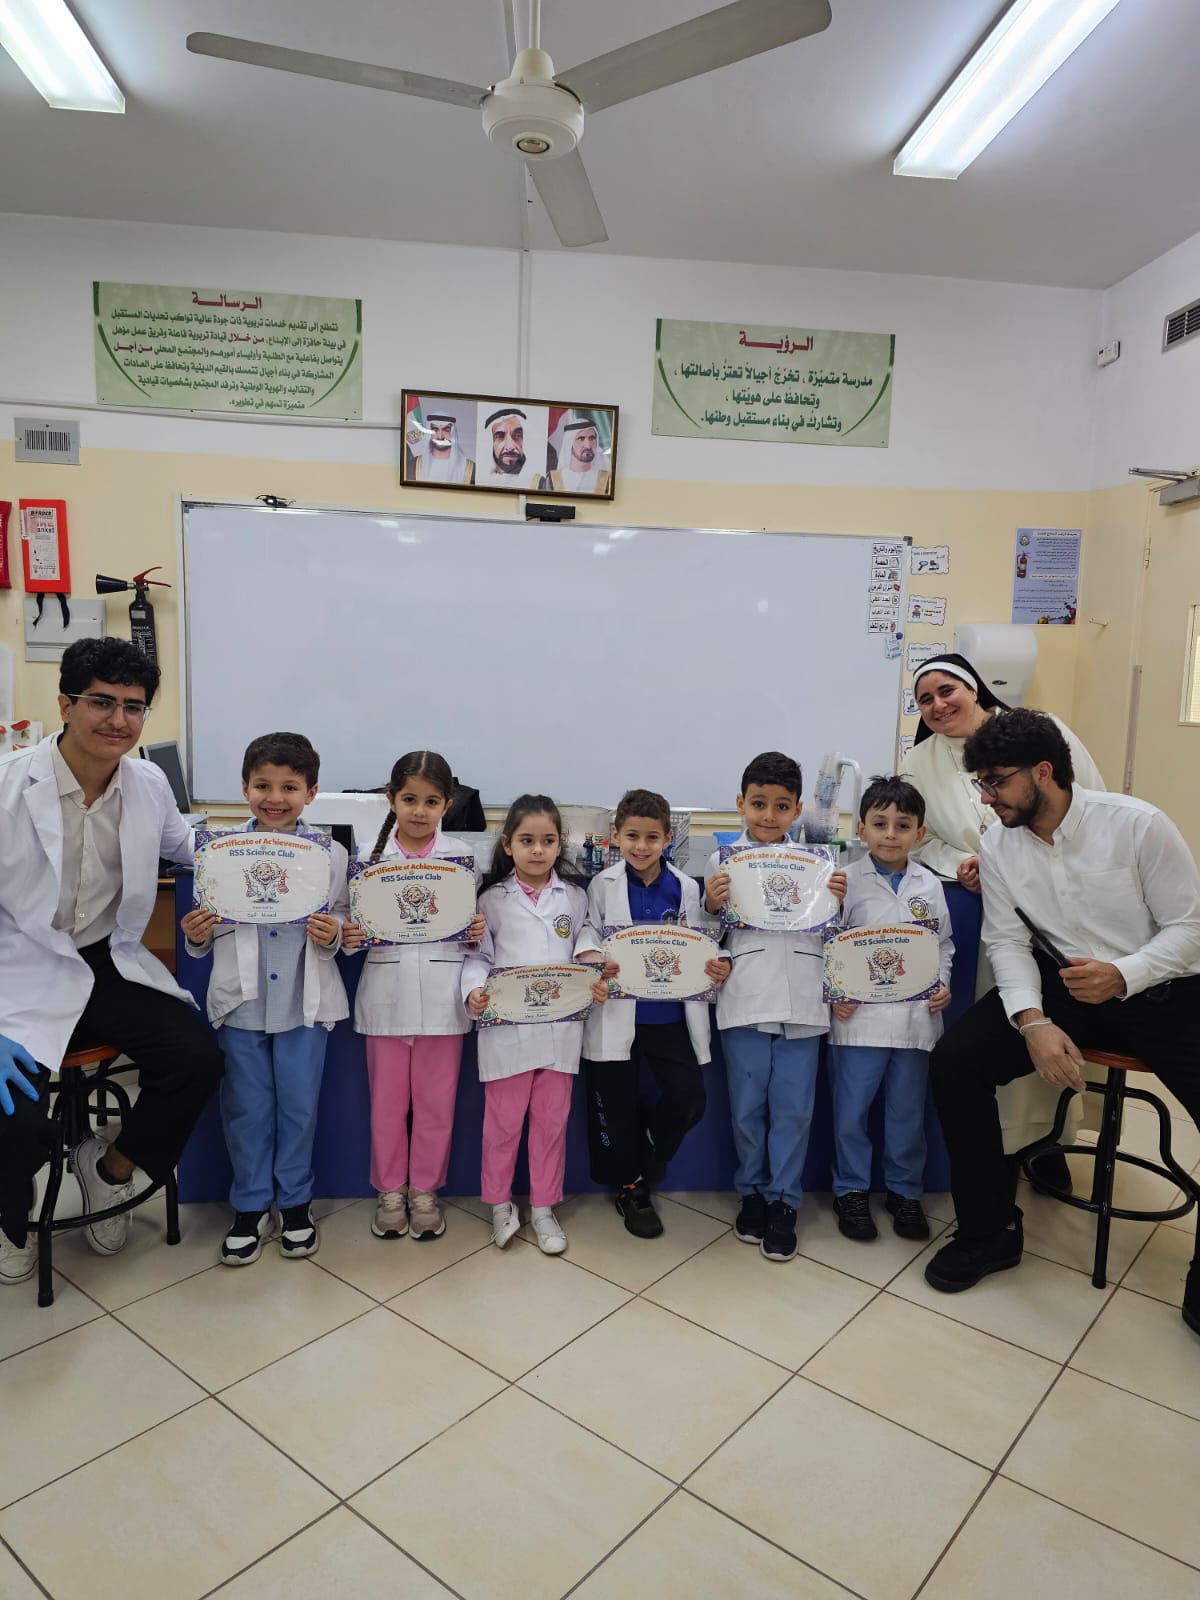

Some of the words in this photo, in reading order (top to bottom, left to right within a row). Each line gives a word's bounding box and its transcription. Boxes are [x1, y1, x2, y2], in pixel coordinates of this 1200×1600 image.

[112, 308, 142, 320] المستقبل
[144, 311, 168, 321] تحديات
[170, 312, 193, 323] تواكب
[194, 313, 212, 324] عالية
[213, 314, 228, 327] جودة
[230, 316, 242, 326] ذات
[243, 316, 264, 328] تربوية
[265, 318, 287, 328] خدمات
[288, 320, 308, 331] تقديم
[112, 325, 130, 336] مؤهل
[131, 326, 146, 336] عمل
[148, 328, 167, 338] وفريق
[168, 328, 187, 337] فاعلة
[188, 330, 209, 342] تربوية
[210, 331, 226, 342] قيادة
[228, 332, 251, 342] خلال
[252, 334, 265, 344] من
[739, 330, 814, 354] الرؤية
[138, 344, 152, 353] من
[323, 338, 337, 349] بيئة
[338, 339, 346, 350] في
[154, 344, 176, 355] المحلي
[178, 346, 209, 357] والمجتمع
[262, 351, 285, 362] الطلبة
[286, 354, 294, 364] مع
[296, 353, 320, 364] بفاعلية
[124, 359, 149, 368] العادات
[150, 361, 163, 370] على
[191, 362, 214, 373] الدينية
[215, 363, 234, 375] بالقيم
[278, 368, 290, 379] بناء
[291, 369, 300, 380] في
[302, 369, 334, 380] المشاركة
[681, 362, 719, 380] بأصالتها
[138, 375, 159, 386] قيادية
[160, 376, 192, 388] بشخصيات
[193, 379, 219, 389] المجتمع
[842, 372, 872, 388] مدرسة
[240, 382, 263, 393] الوطنية
[265, 383, 286, 393] والهوية
[288, 385, 315, 396] والتقاليد
[255, 399, 264, 409] في
[763, 392, 782, 406] على
[733, 412, 770, 427] مستقبل
[772, 414, 789, 429] بناء
[791, 415, 804, 432] في
[211, 840, 253, 851] Certificate
[263, 838, 313, 851] Achievement
[246, 848, 275, 857] Science
[277, 850, 295, 858] Club
[733, 853, 768, 862] Certificate
[364, 865, 402, 878] Certificate
[411, 863, 456, 873] Achievement
[790, 863, 805, 871] Club
[616, 930, 651, 940] Certificate
[660, 930, 702, 941] Achievement
[838, 929, 874, 941] Certificate
